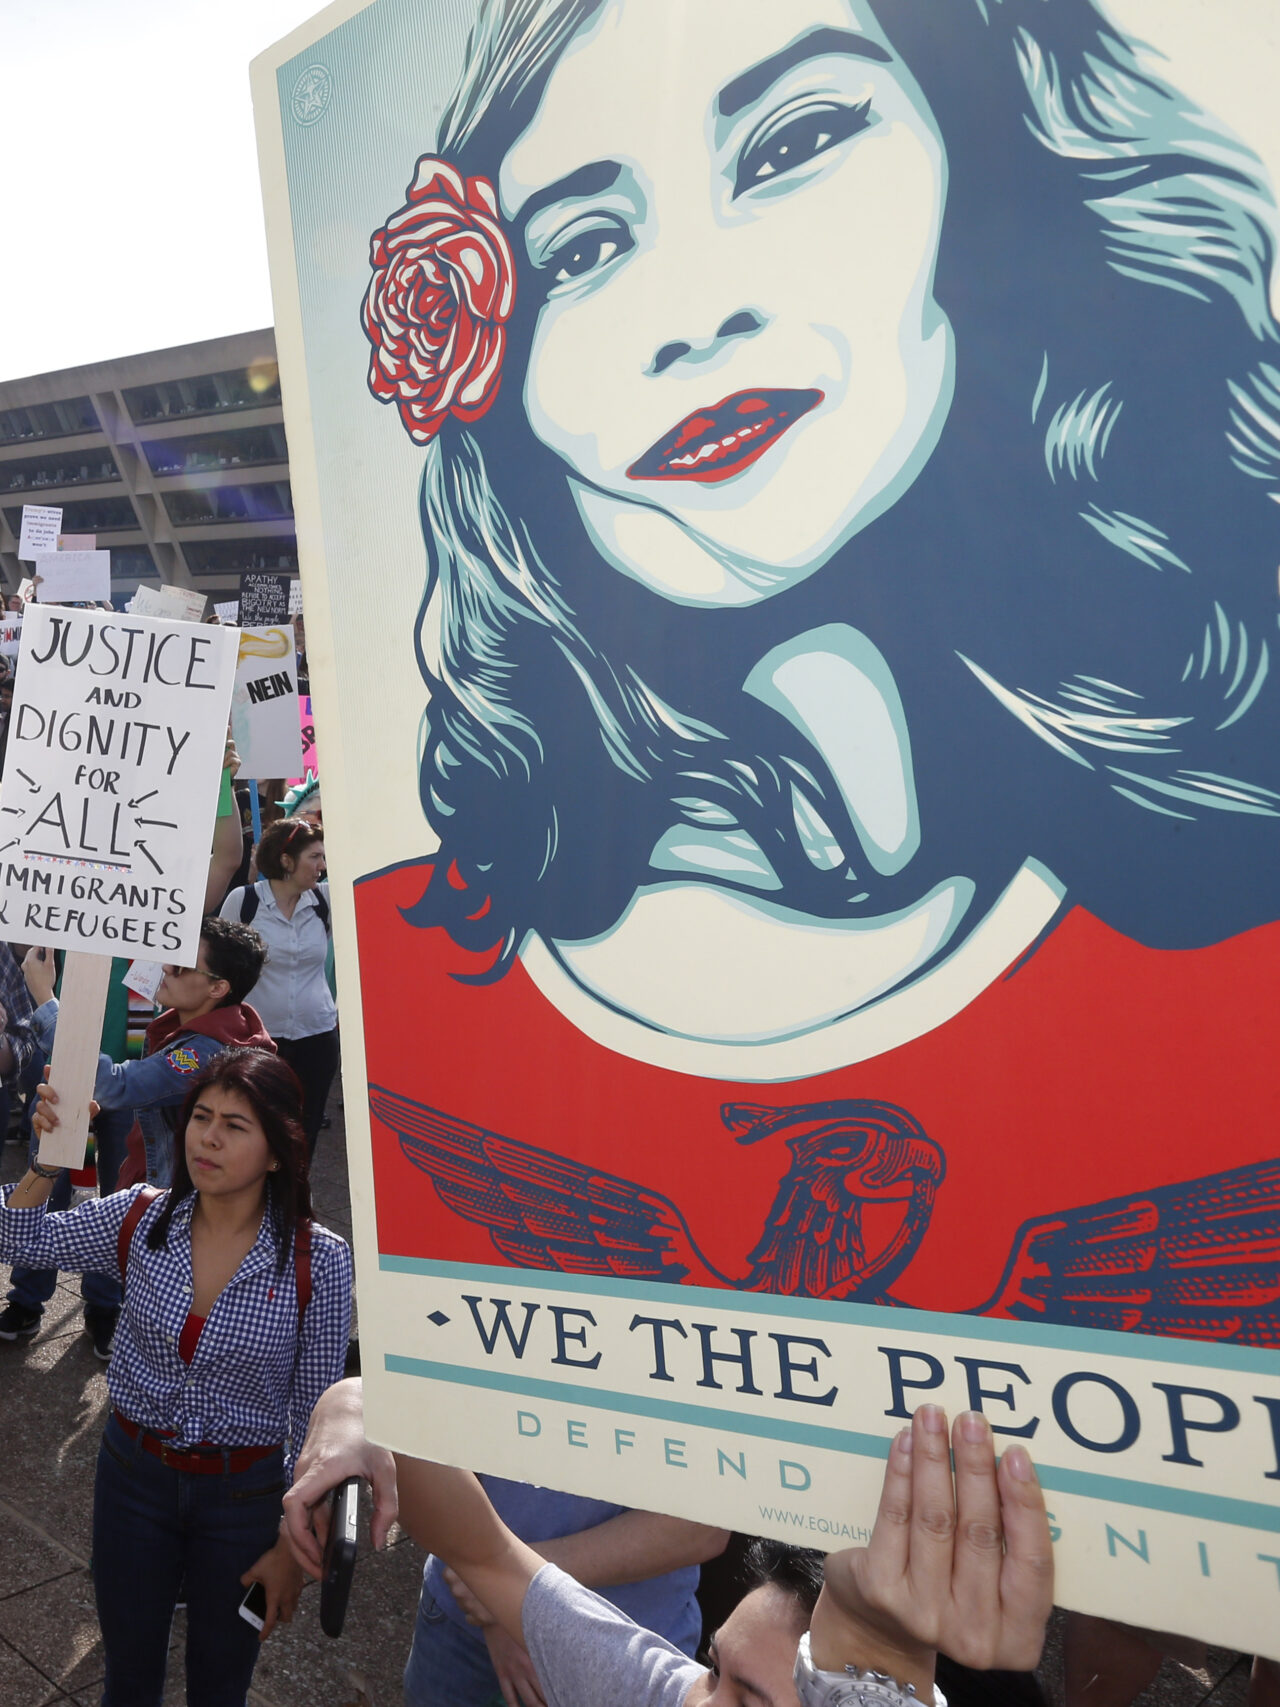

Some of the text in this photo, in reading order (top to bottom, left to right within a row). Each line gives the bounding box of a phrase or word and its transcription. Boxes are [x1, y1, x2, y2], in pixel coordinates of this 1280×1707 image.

[244, 574, 278, 584] APATHY
[242, 598, 278, 608] BIGOTRY
[31, 617, 216, 690] JUSTICE
[85, 686, 142, 709] AND
[246, 670, 294, 704] NEIN
[16, 704, 190, 776] DIGNITY
[74, 764, 120, 796] FOR
[25, 792, 130, 856] ALL
[24, 903, 182, 950] REFUGEES
[460, 1294, 603, 1370] WE
[628, 1313, 840, 1408] THE
[516, 1410, 812, 1492] DEFEND
[758, 1505, 872, 1542] WWW.EQUALH
